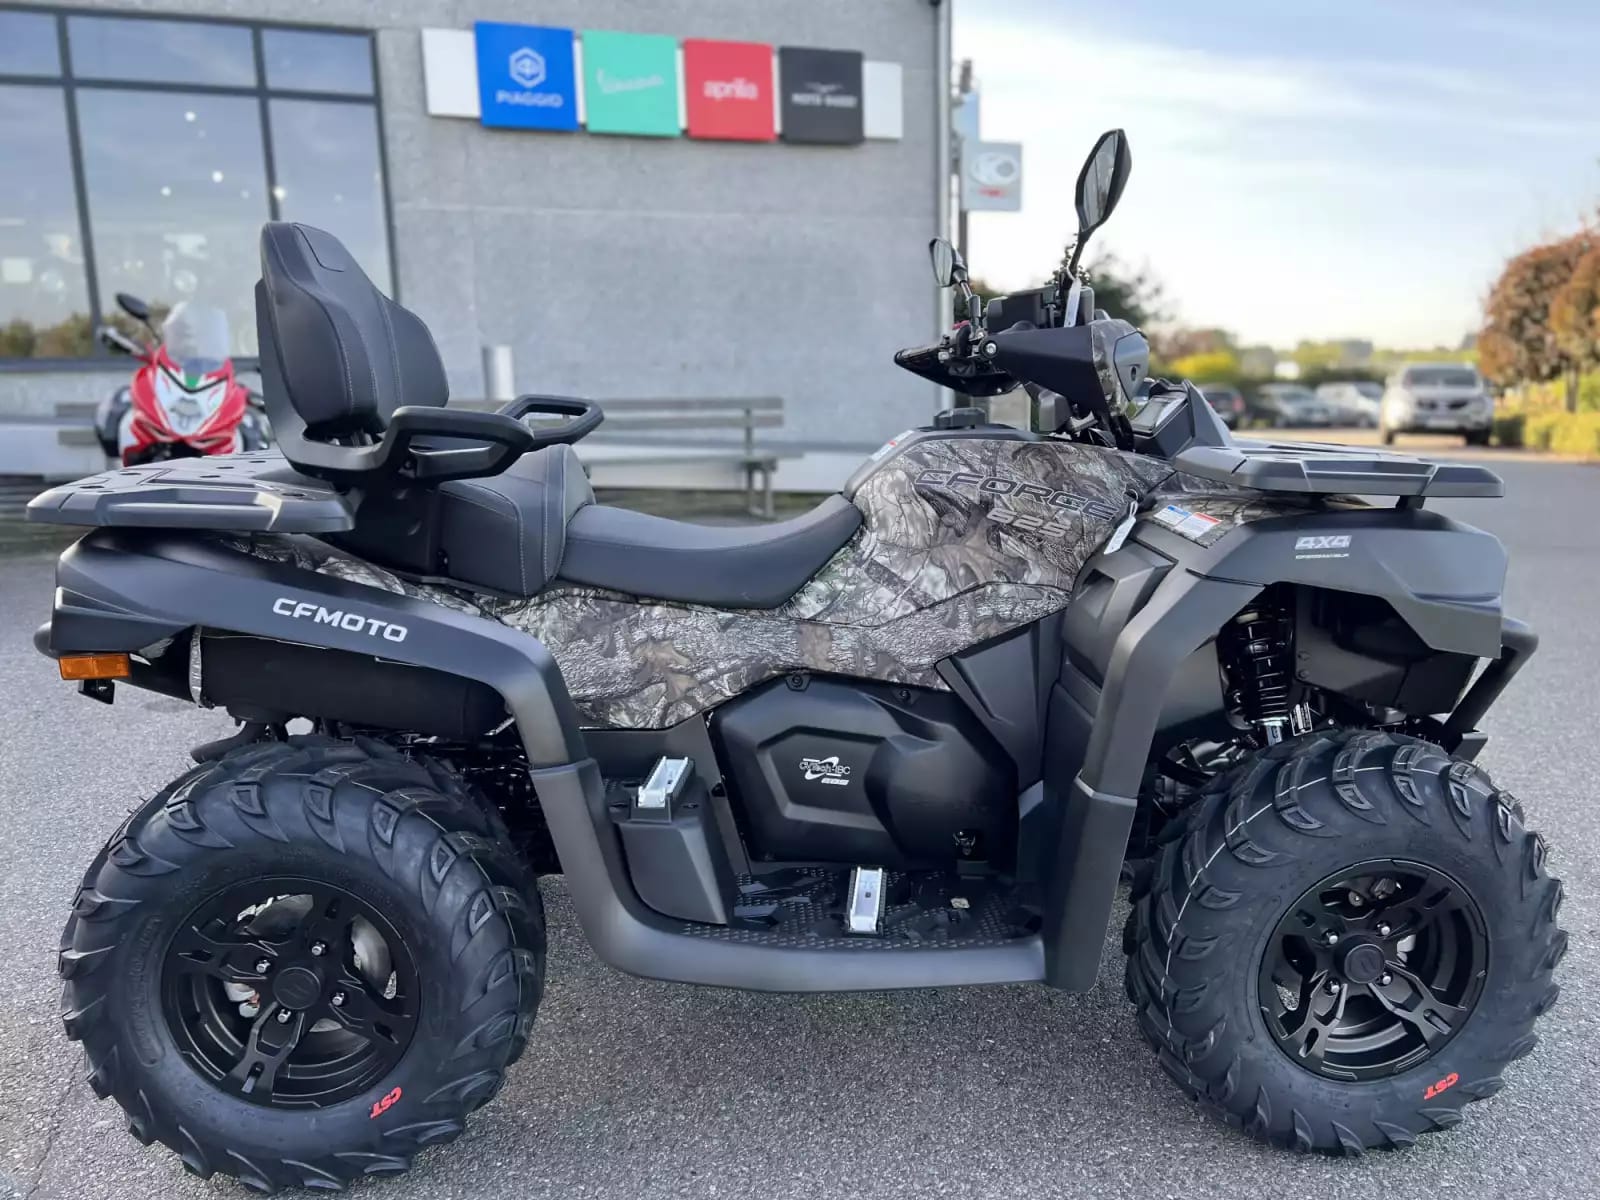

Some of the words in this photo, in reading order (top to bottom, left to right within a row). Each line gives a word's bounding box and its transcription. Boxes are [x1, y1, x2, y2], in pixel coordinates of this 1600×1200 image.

[495, 89, 564, 109] PIAGGIO
[915, 469, 1120, 522] CFORCE
[272, 597, 408, 643] CFMOTO
[369, 1086, 403, 1120] CST
[1423, 1071, 1460, 1101] CST
